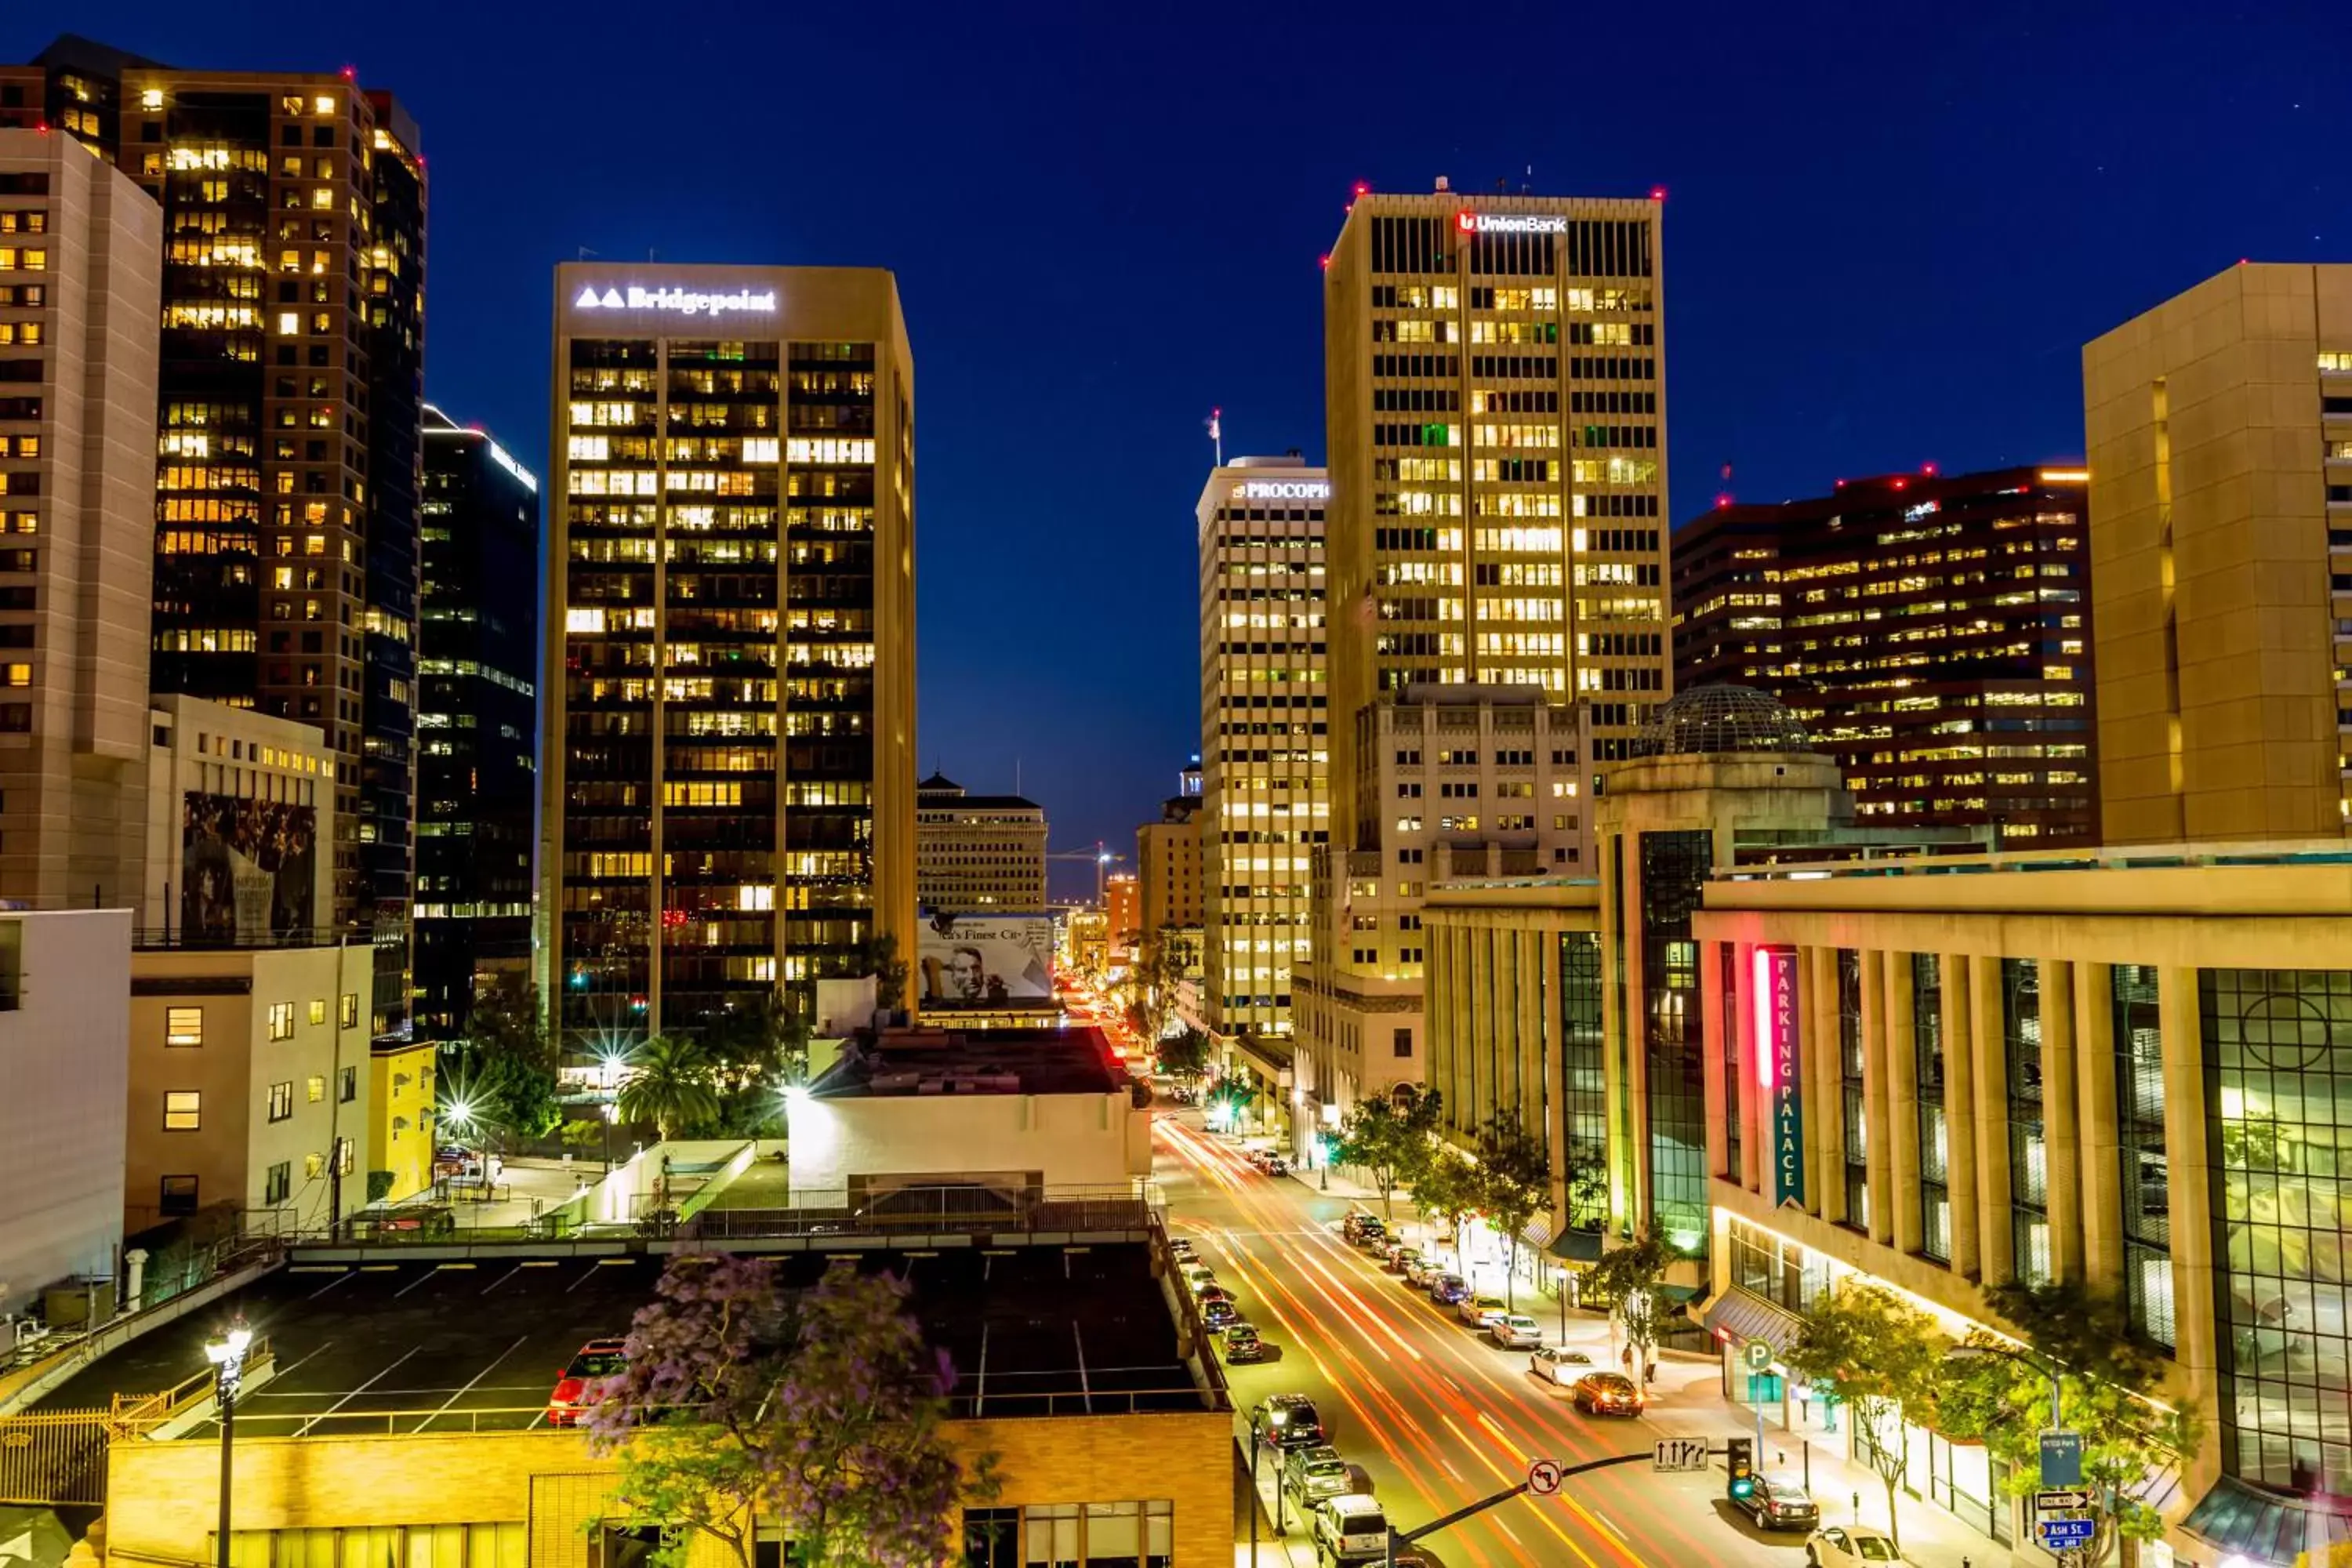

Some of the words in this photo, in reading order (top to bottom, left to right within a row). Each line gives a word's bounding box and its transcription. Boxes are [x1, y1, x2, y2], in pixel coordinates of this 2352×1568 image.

[1476, 215, 1566, 232] UnionBank
[628, 287, 775, 316] Bridgepoint
[965, 929, 996, 939] Finest
[1777, 958, 1792, 1077] PARKING
[1780, 1085, 1794, 1187] PALACE
[1751, 1346, 1766, 1365] P
